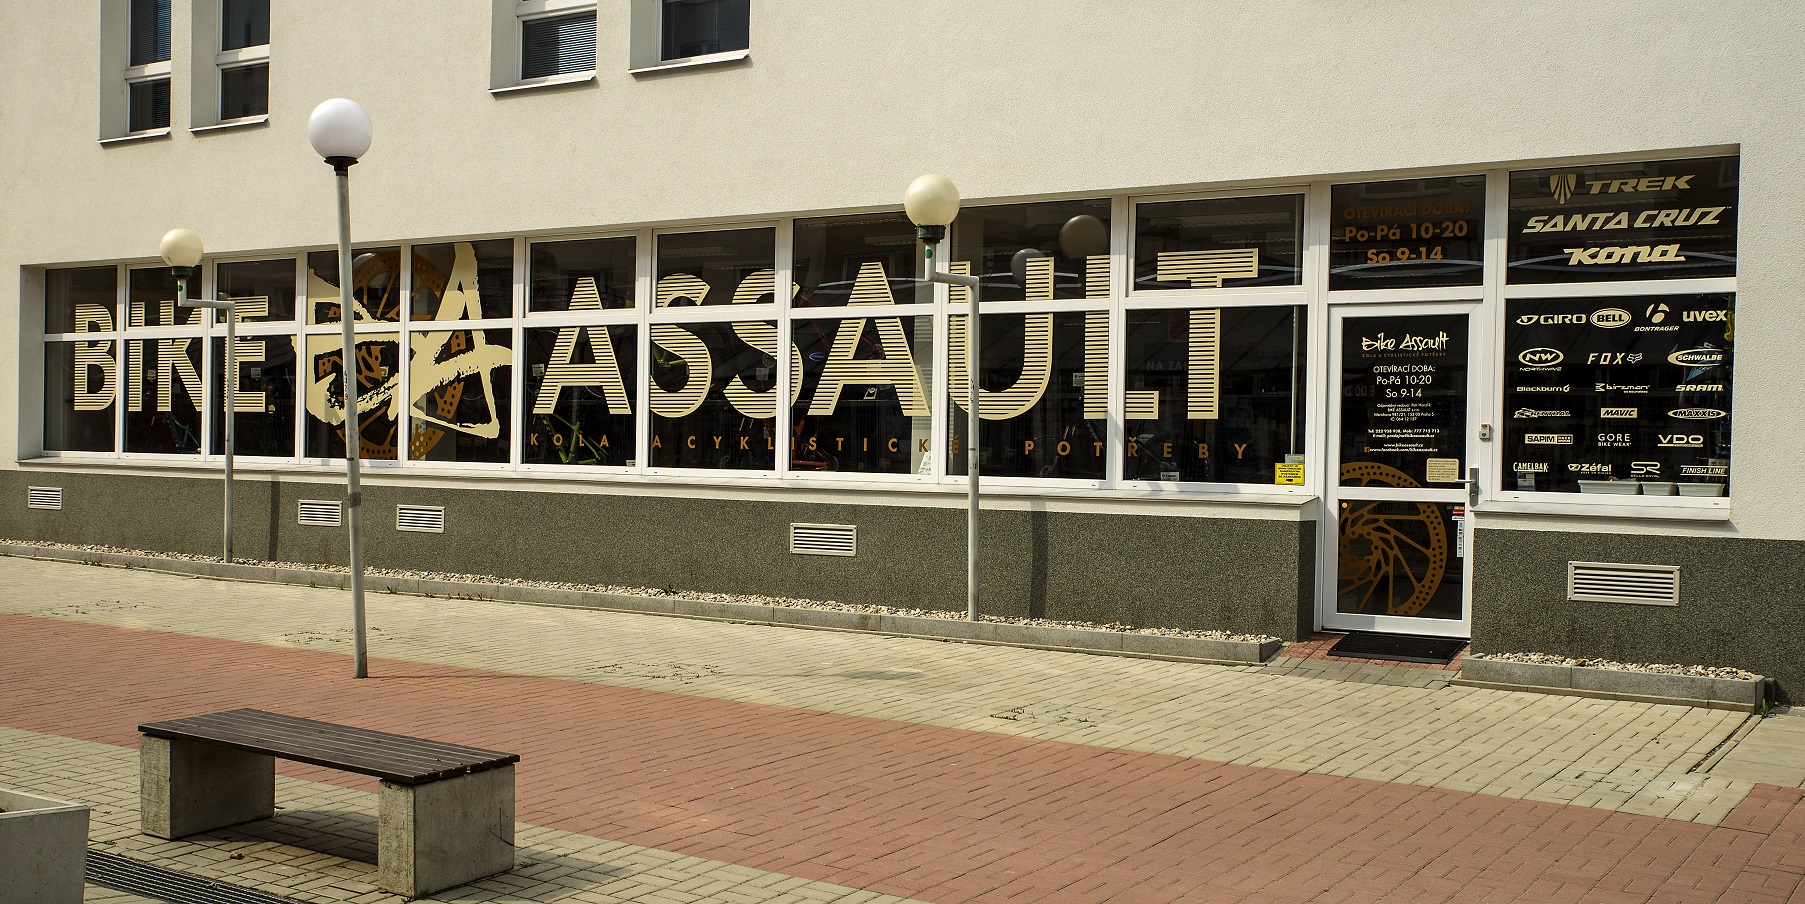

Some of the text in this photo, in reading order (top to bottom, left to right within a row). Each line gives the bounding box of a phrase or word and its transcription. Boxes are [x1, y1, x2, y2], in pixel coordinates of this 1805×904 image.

[1585, 174, 1696, 195] TREK
[1422, 201, 1470, 216] DOBA:
[1522, 211, 1629, 233] SANTA
[1345, 220, 1468, 242] Po-Pá 10-20
[1367, 246, 1443, 265] So 9-14
[1540, 314, 1587, 325] GIRO
[1596, 313, 1624, 323] BELL
[1682, 310, 1728, 322] uvex
[532, 247, 1259, 420] ASSAULT
[1361, 332, 1396, 351] Bike
[73, 295, 269, 413] BIKE
[1587, 353, 1626, 365] FOX
[1376, 374, 1432, 385] Po-Pá 10-20
[1385, 388, 1398, 398] So
[1400, 388, 1423, 398] 9-14
[1675, 384, 1723, 392] SRAM
[1527, 435, 1555, 443] SAPIM
[1598, 433, 1631, 441] GORE
[1657, 434, 1704, 444] VDO
[530, 433, 609, 448] KOLA
[1025, 436, 1247, 459] POTŘEBY
[1580, 462, 1612, 472] Zéfal
